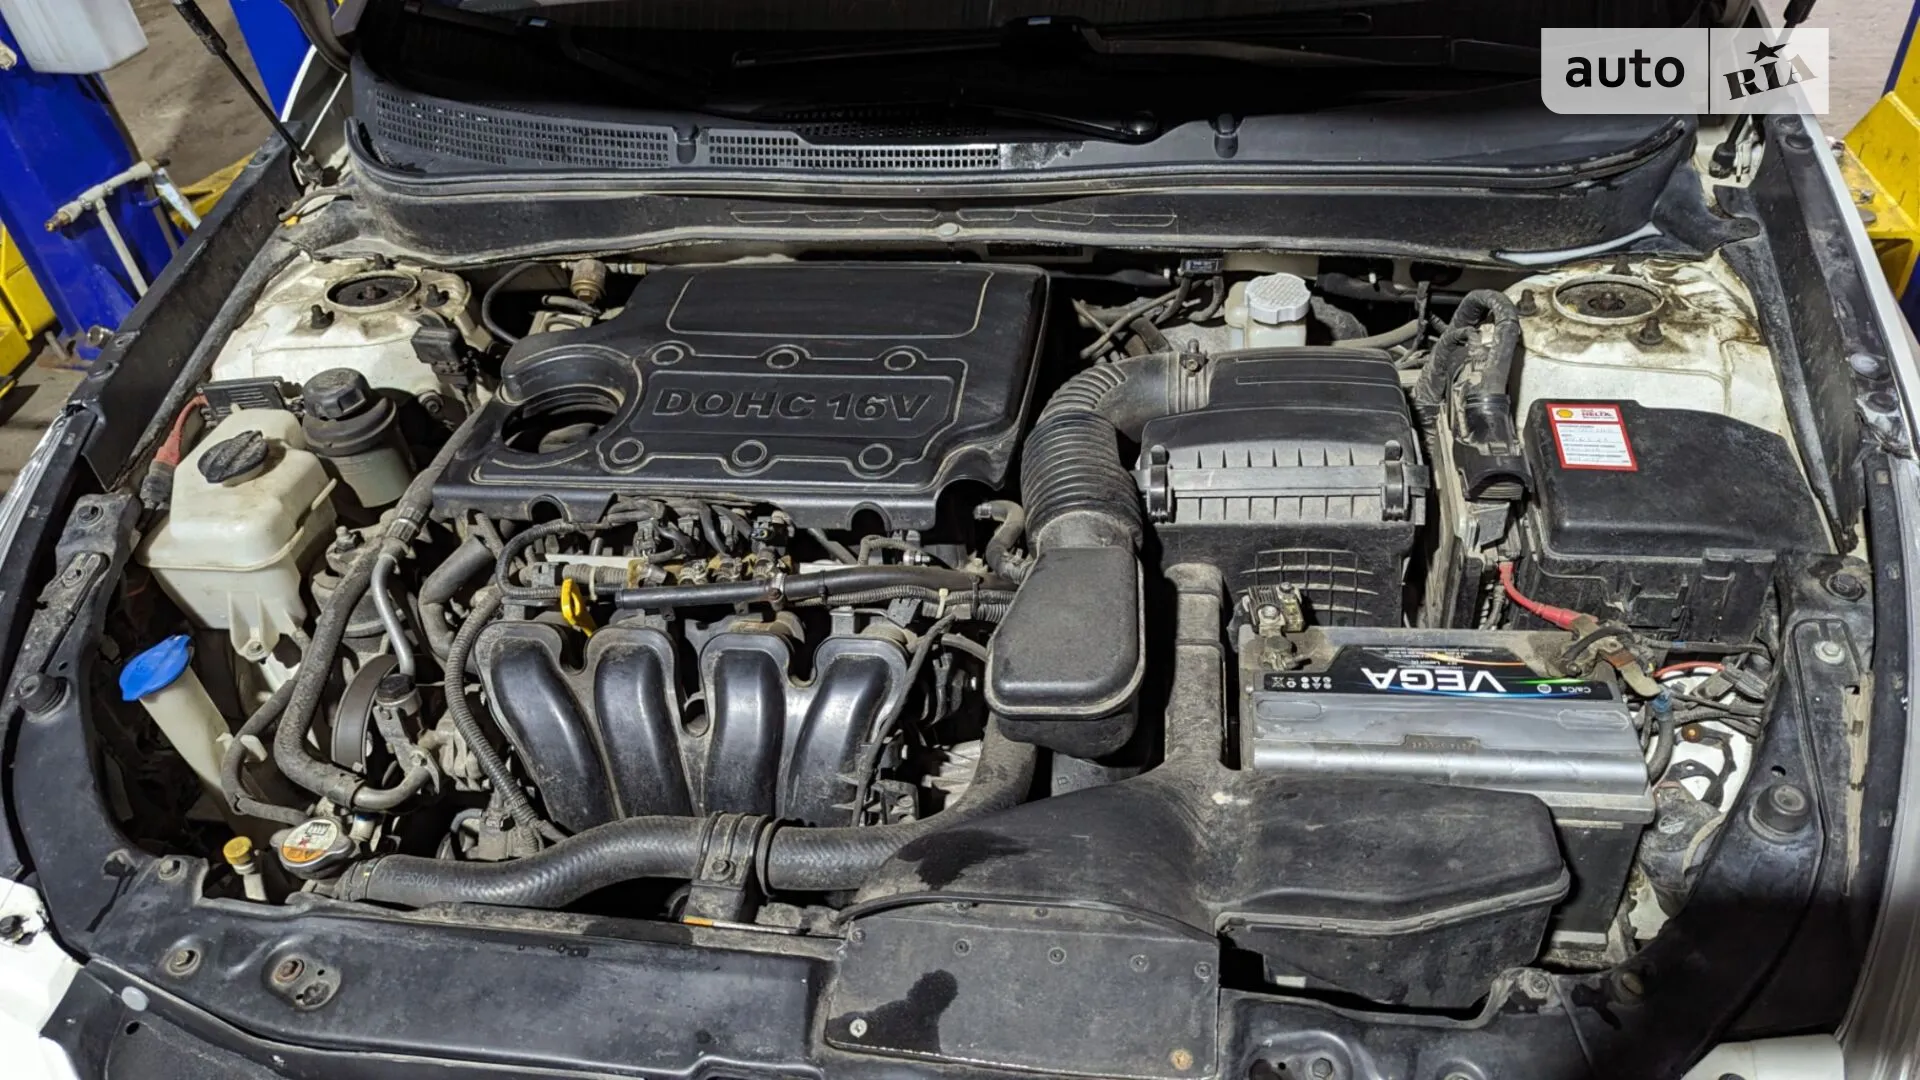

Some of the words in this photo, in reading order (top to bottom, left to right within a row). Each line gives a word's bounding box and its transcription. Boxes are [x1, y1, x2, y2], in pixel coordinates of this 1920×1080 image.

[652, 388, 816, 420] DOHC
[826, 392, 931, 421] 16V
[1360, 667, 1507, 693] VEGA
